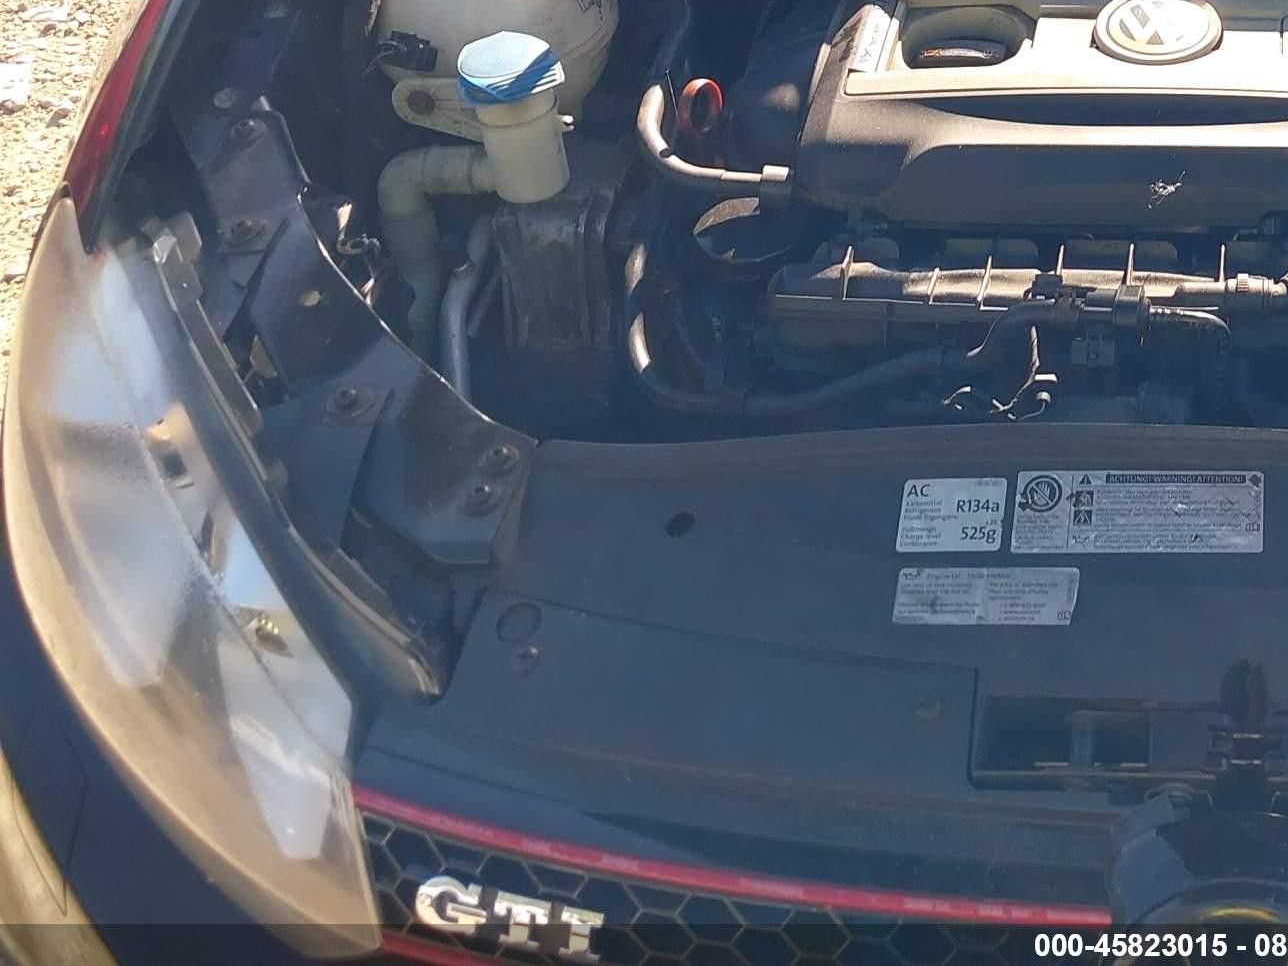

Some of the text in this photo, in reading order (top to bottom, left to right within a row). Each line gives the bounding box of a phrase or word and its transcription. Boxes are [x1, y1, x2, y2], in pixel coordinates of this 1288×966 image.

[1196, 474, 1244, 483] ATTENTION!
[907, 484, 931, 497] AC
[957, 499, 1000, 513] R134a
[960, 526, 997, 544] 525g
[415, 875, 605, 965] GTI
